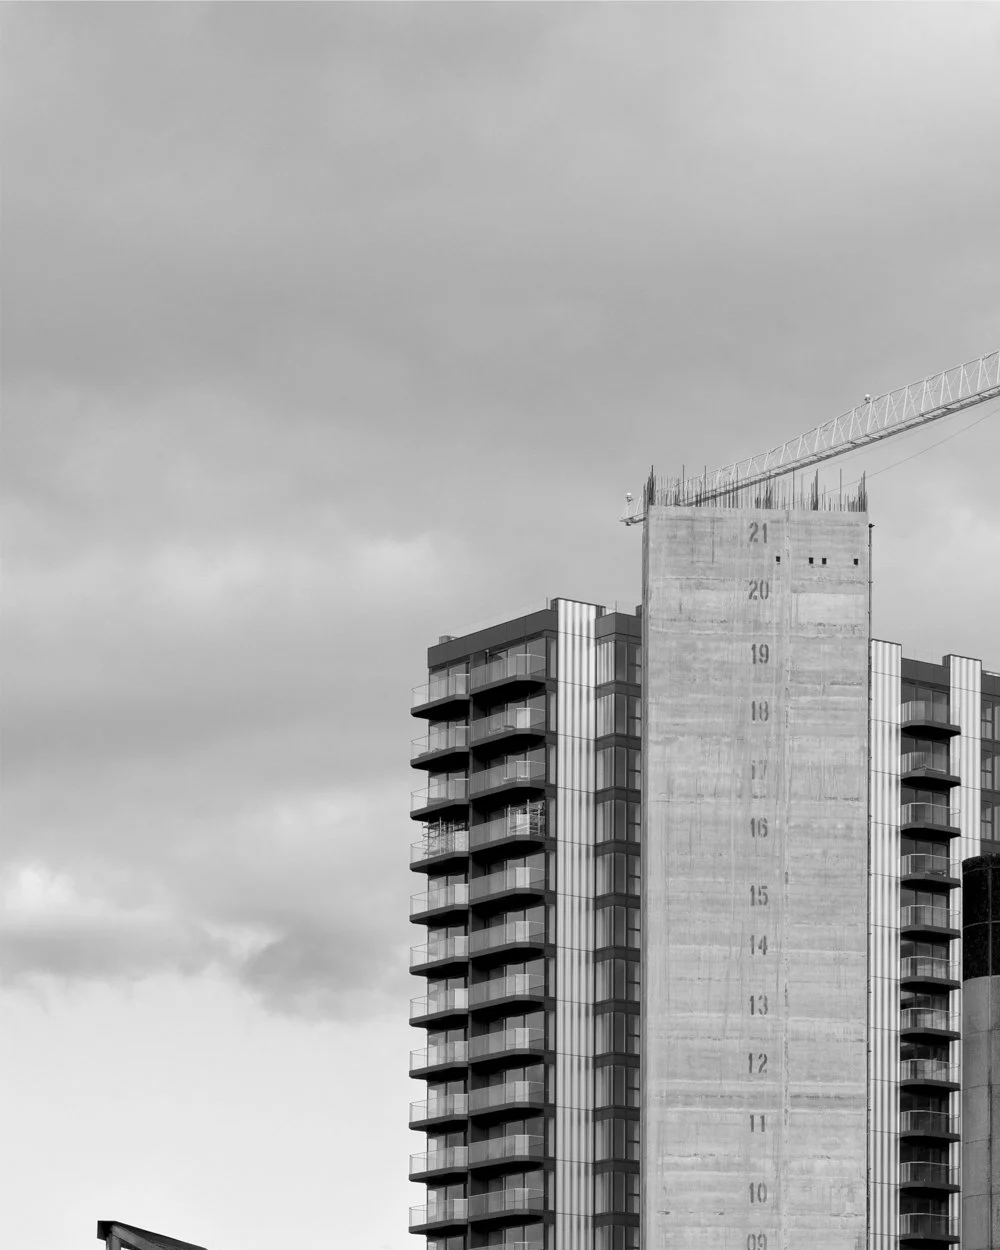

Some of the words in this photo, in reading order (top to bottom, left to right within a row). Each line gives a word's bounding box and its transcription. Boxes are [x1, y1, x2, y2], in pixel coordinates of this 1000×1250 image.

[749, 522, 768, 543] 21
[749, 580, 769, 600] 20
[751, 644, 769, 664] 19
[751, 701, 769, 721] 18
[751, 760, 768, 780] 17
[750, 818, 768, 838] 16
[750, 885, 769, 906] 15
[750, 935, 768, 955] 14
[749, 995, 768, 1015] 13
[748, 1053, 768, 1073] 12
[749, 1114, 766, 1132] 11
[748, 1182, 768, 1203] 10
